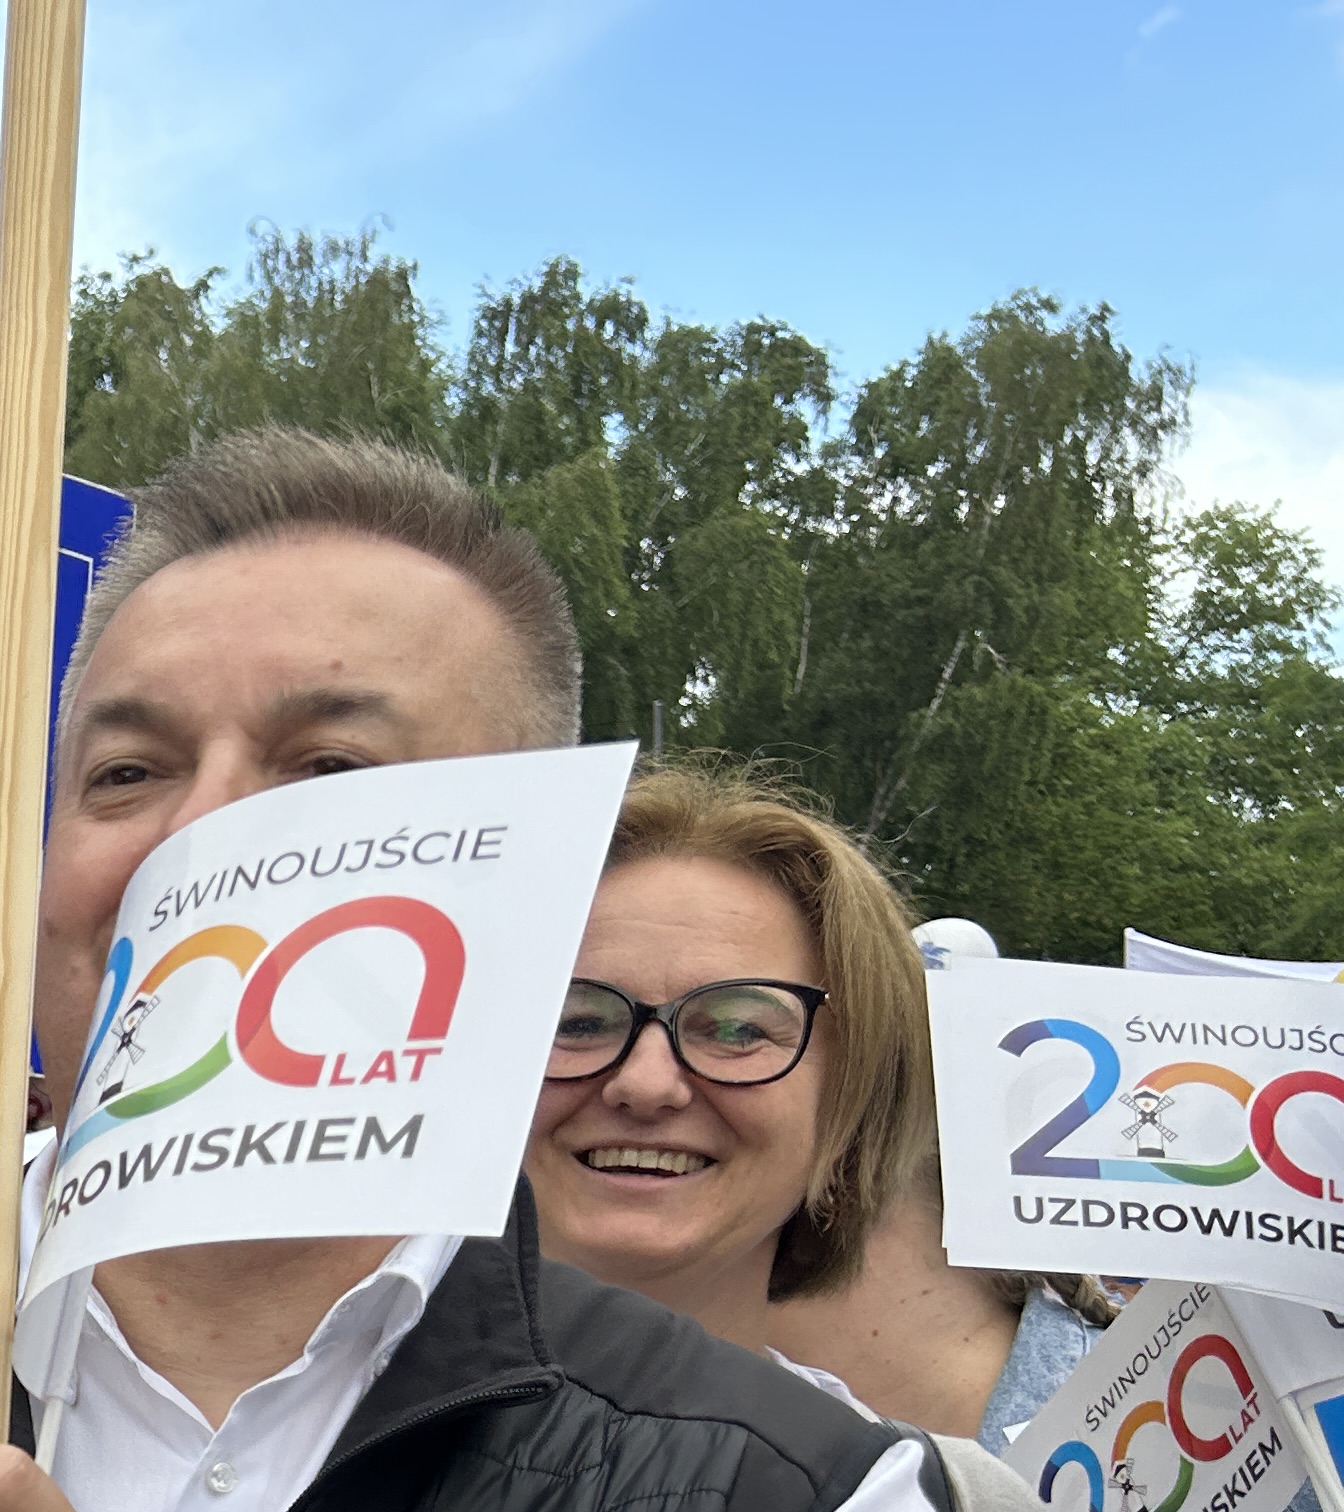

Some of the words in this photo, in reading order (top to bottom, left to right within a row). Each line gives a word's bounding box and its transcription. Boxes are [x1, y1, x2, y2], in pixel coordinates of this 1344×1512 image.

[148, 825, 508, 932] ŚWINOUJŚCIE
[329, 1046, 443, 1088] LAT
[1085, 1282, 1212, 1431] ŚWINOUJŚCIE
[1230, 1392, 1261, 1444] LAT
